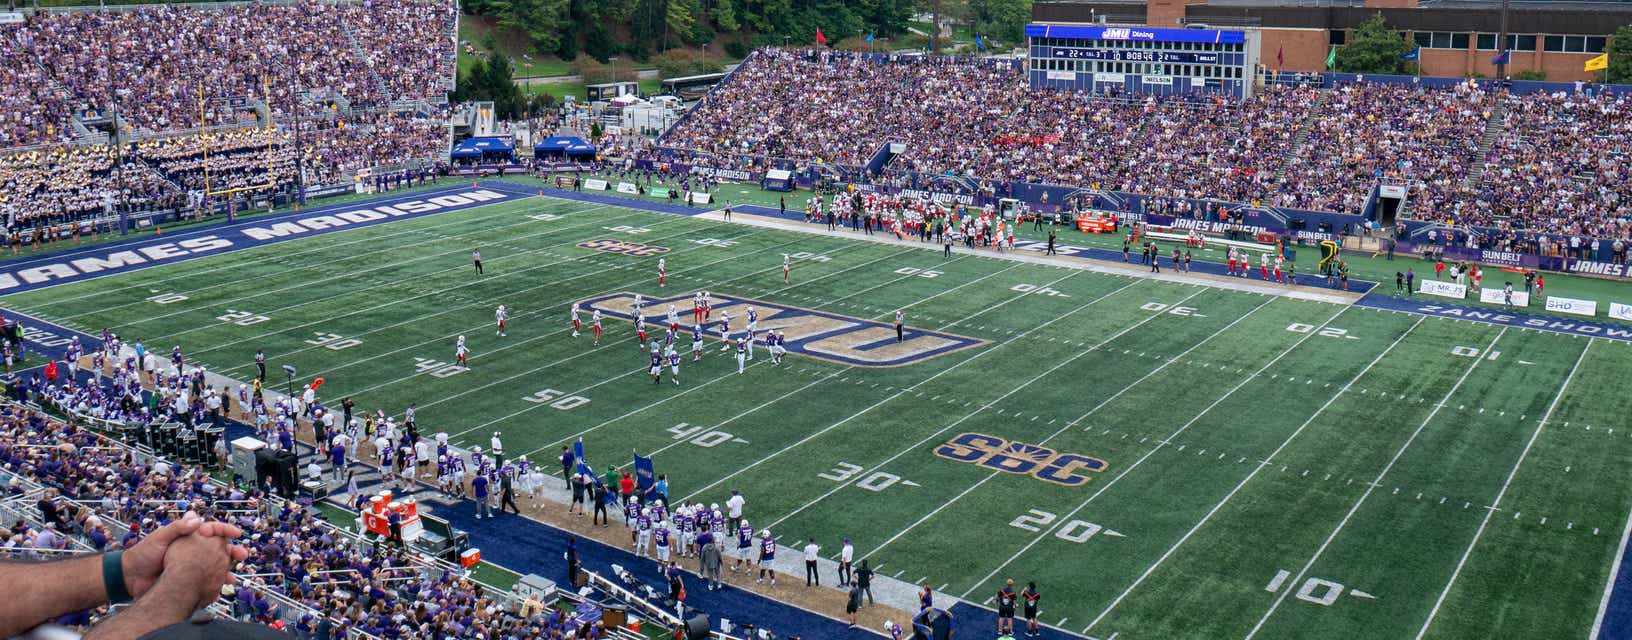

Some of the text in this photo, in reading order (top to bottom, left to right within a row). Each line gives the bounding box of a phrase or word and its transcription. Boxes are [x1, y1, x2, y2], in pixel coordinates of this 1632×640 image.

[1102, 28, 1130, 39] JMU
[715, 168, 751, 180] MADISON
[901, 189, 929, 200] JAMES
[241, 190, 507, 241] MADISON
[1171, 218, 1210, 232] JAMES
[1298, 231, 1332, 241] SUN BELT
[1482, 250, 1500, 260] SUN
[1501, 252, 1521, 262] BELT
[1570, 260, 1623, 276] JAMES
[217, 309, 271, 326] 20
[1419, 305, 1516, 322] ZANE
[574, 292, 993, 367] JMU
[305, 332, 363, 350] 30
[415, 357, 471, 378] 40
[522, 388, 591, 411] 50
[666, 422, 734, 448] 40
[932, 432, 1109, 487] SBC
[817, 461, 901, 492] 30
[368, 517, 376, 528] G
[1008, 508, 1102, 543] 20
[1264, 569, 1345, 606] 10
